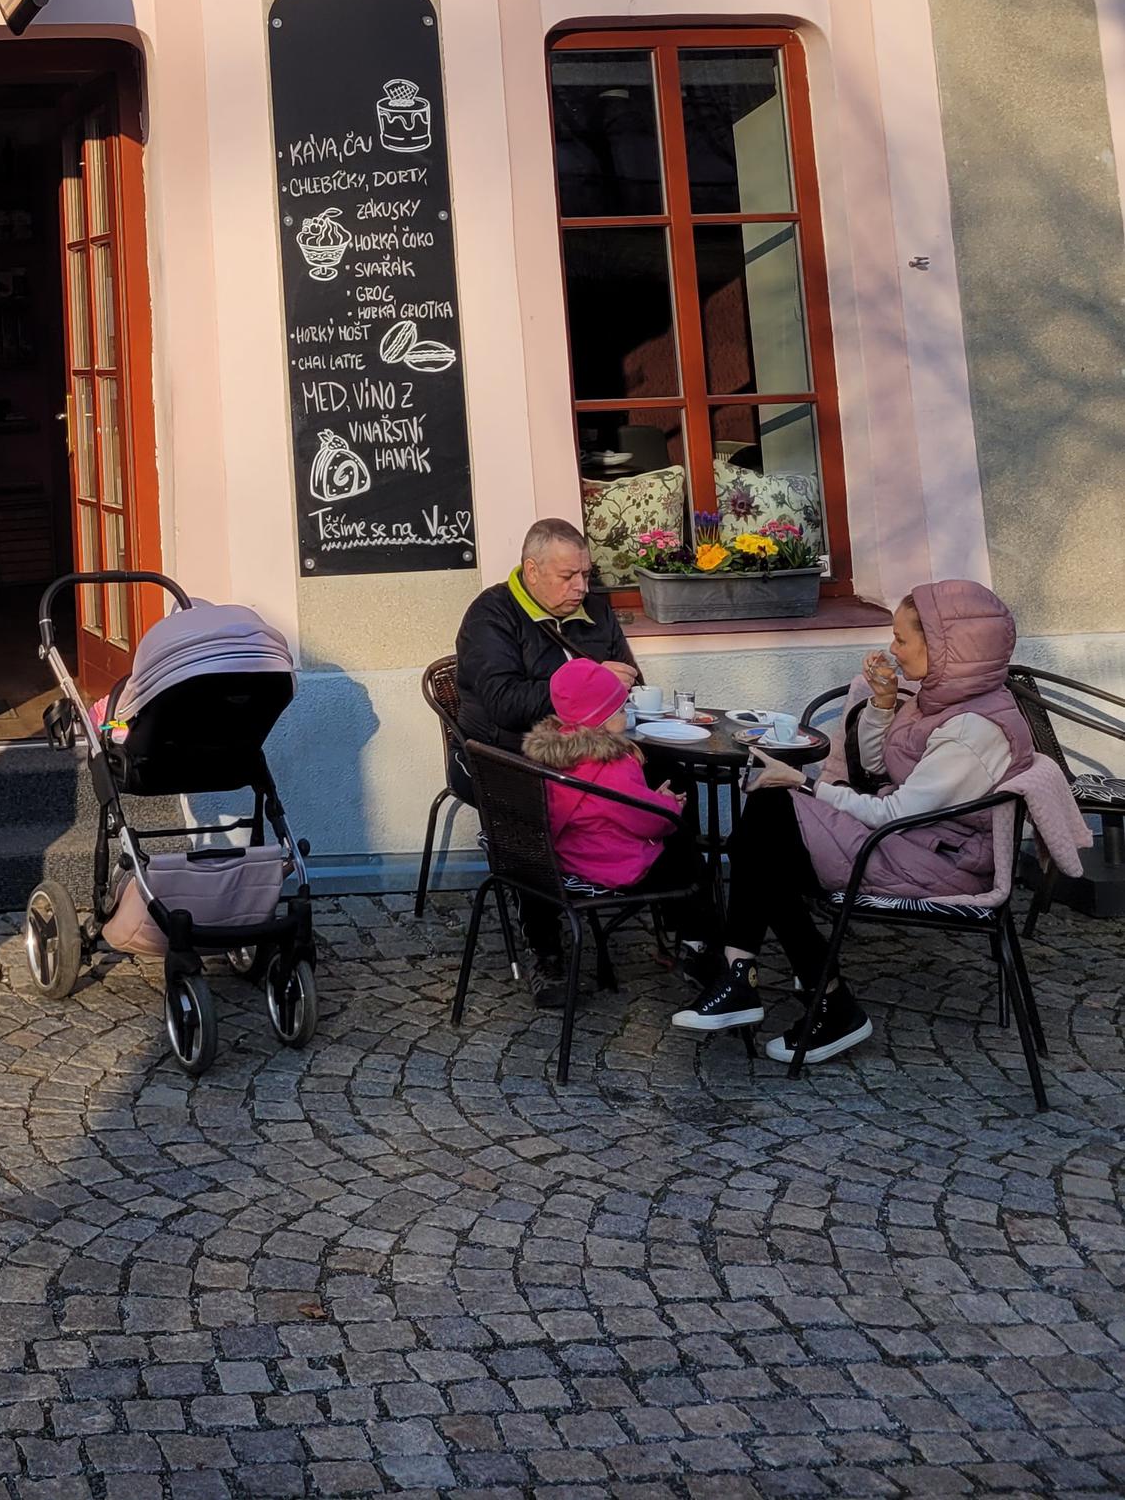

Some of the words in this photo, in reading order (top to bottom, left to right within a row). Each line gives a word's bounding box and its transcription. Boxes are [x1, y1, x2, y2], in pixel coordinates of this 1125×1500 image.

[356, 198, 422, 220] ZÁKUSKY
[354, 224, 399, 252] HORKÁ
[402, 225, 434, 248] ČOKO
[355, 253, 416, 278] SVAŘÁK
[357, 299, 396, 319] HORKÁ
[400, 300, 453, 319] GRIOTKA
[296, 317, 335, 344] HORKÝ
[338, 321, 372, 340] MOŠT
[298, 355, 326, 370] CHAI
[329, 353, 366, 370] LATTE
[352, 377, 395, 411] VÍNO
[400, 382, 414, 408] Z
[348, 413, 427, 443] VINAŘSTVÍ
[375, 443, 431, 474] HANÁK
[308, 507, 366, 540] Těšíme
[370, 522, 386, 538] se
[392, 522, 417, 538] na
[422, 504, 458, 539] Vás
